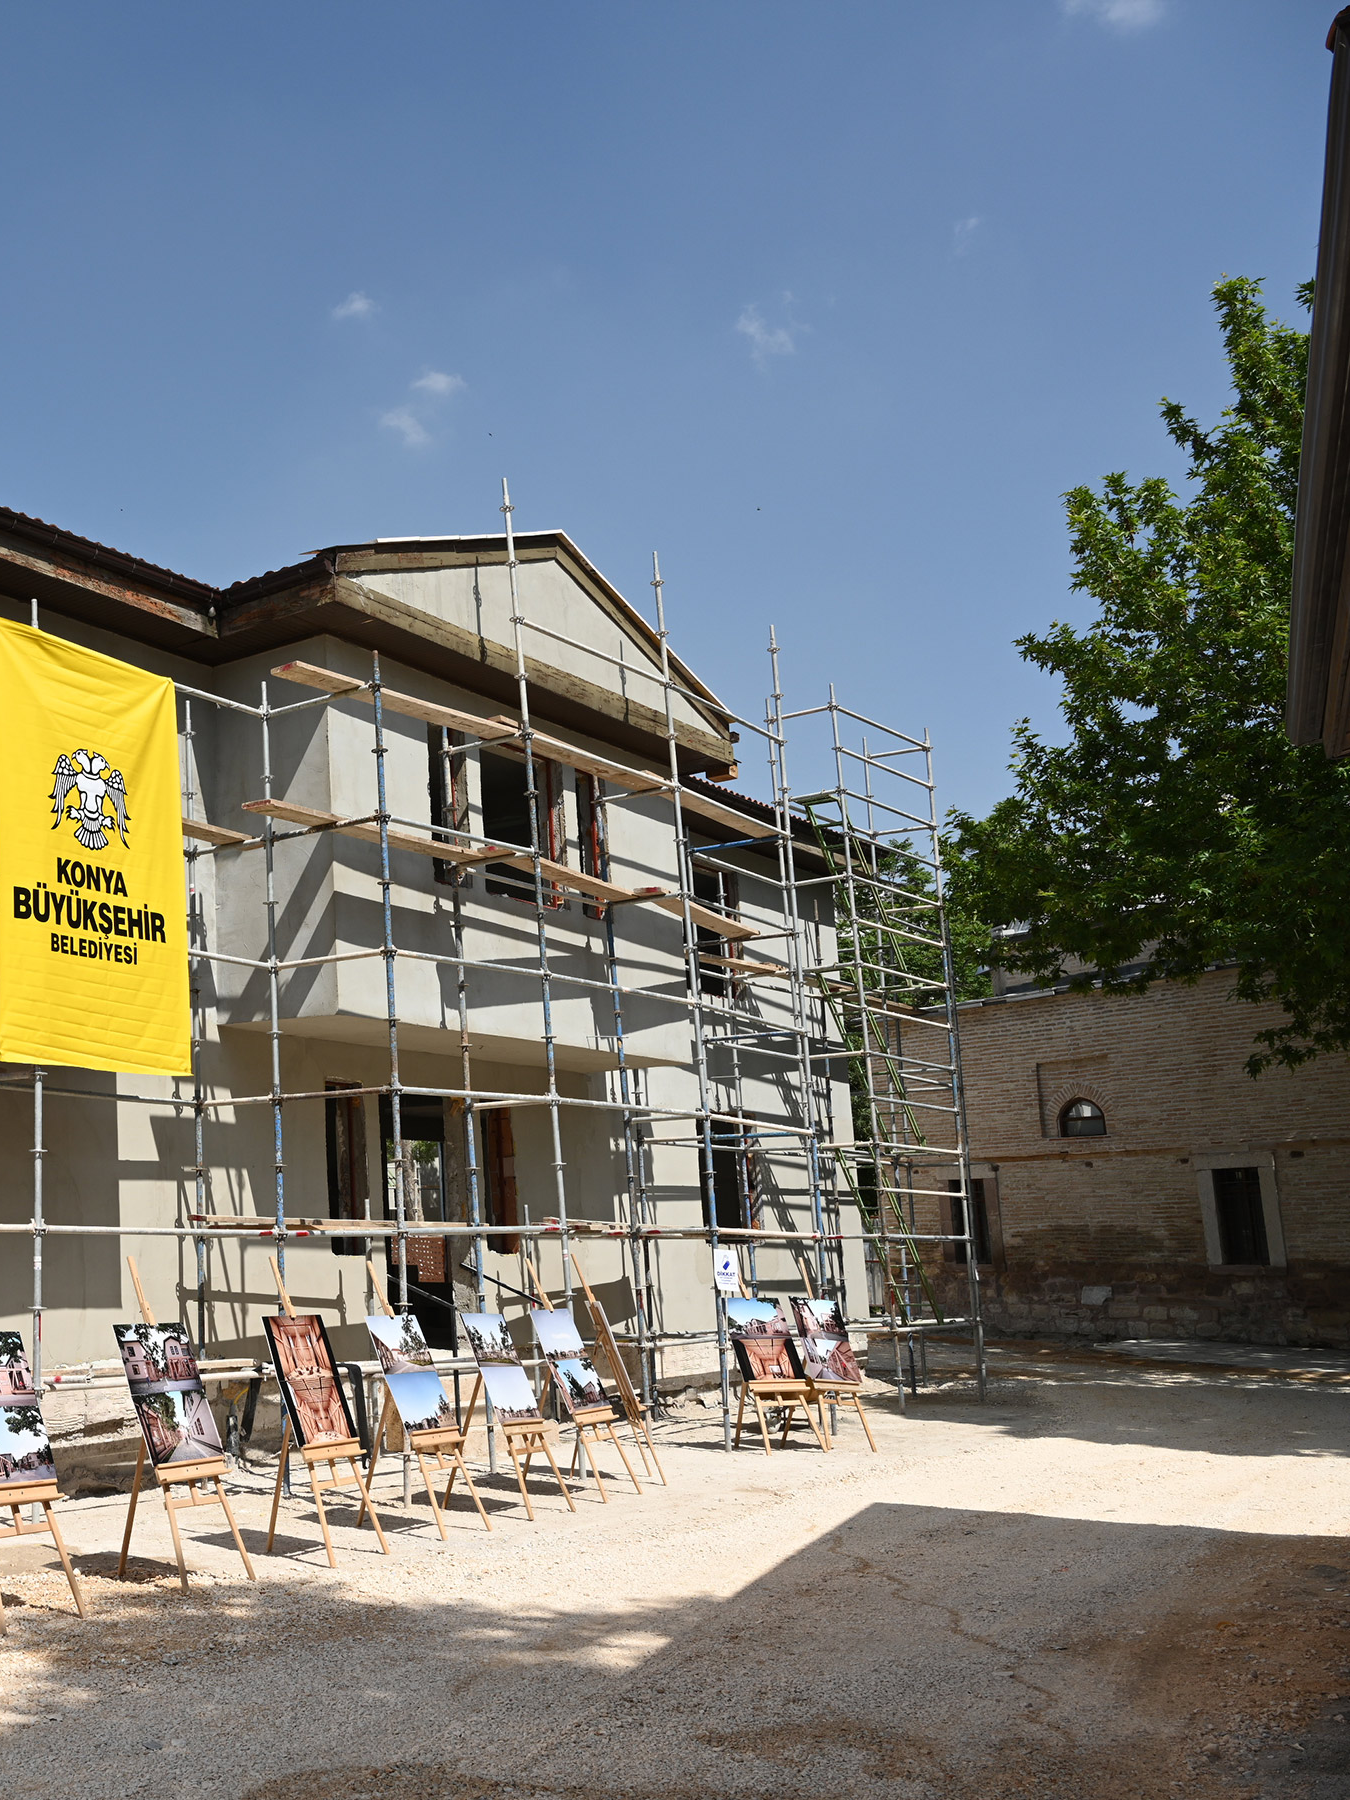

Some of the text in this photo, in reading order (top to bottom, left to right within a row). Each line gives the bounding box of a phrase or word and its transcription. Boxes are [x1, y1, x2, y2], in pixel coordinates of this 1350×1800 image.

[57, 857, 128, 897] KONYA
[13, 882, 167, 944] BÜYÜKŞEHİR
[51, 932, 138, 965] BELEDİYESİ
